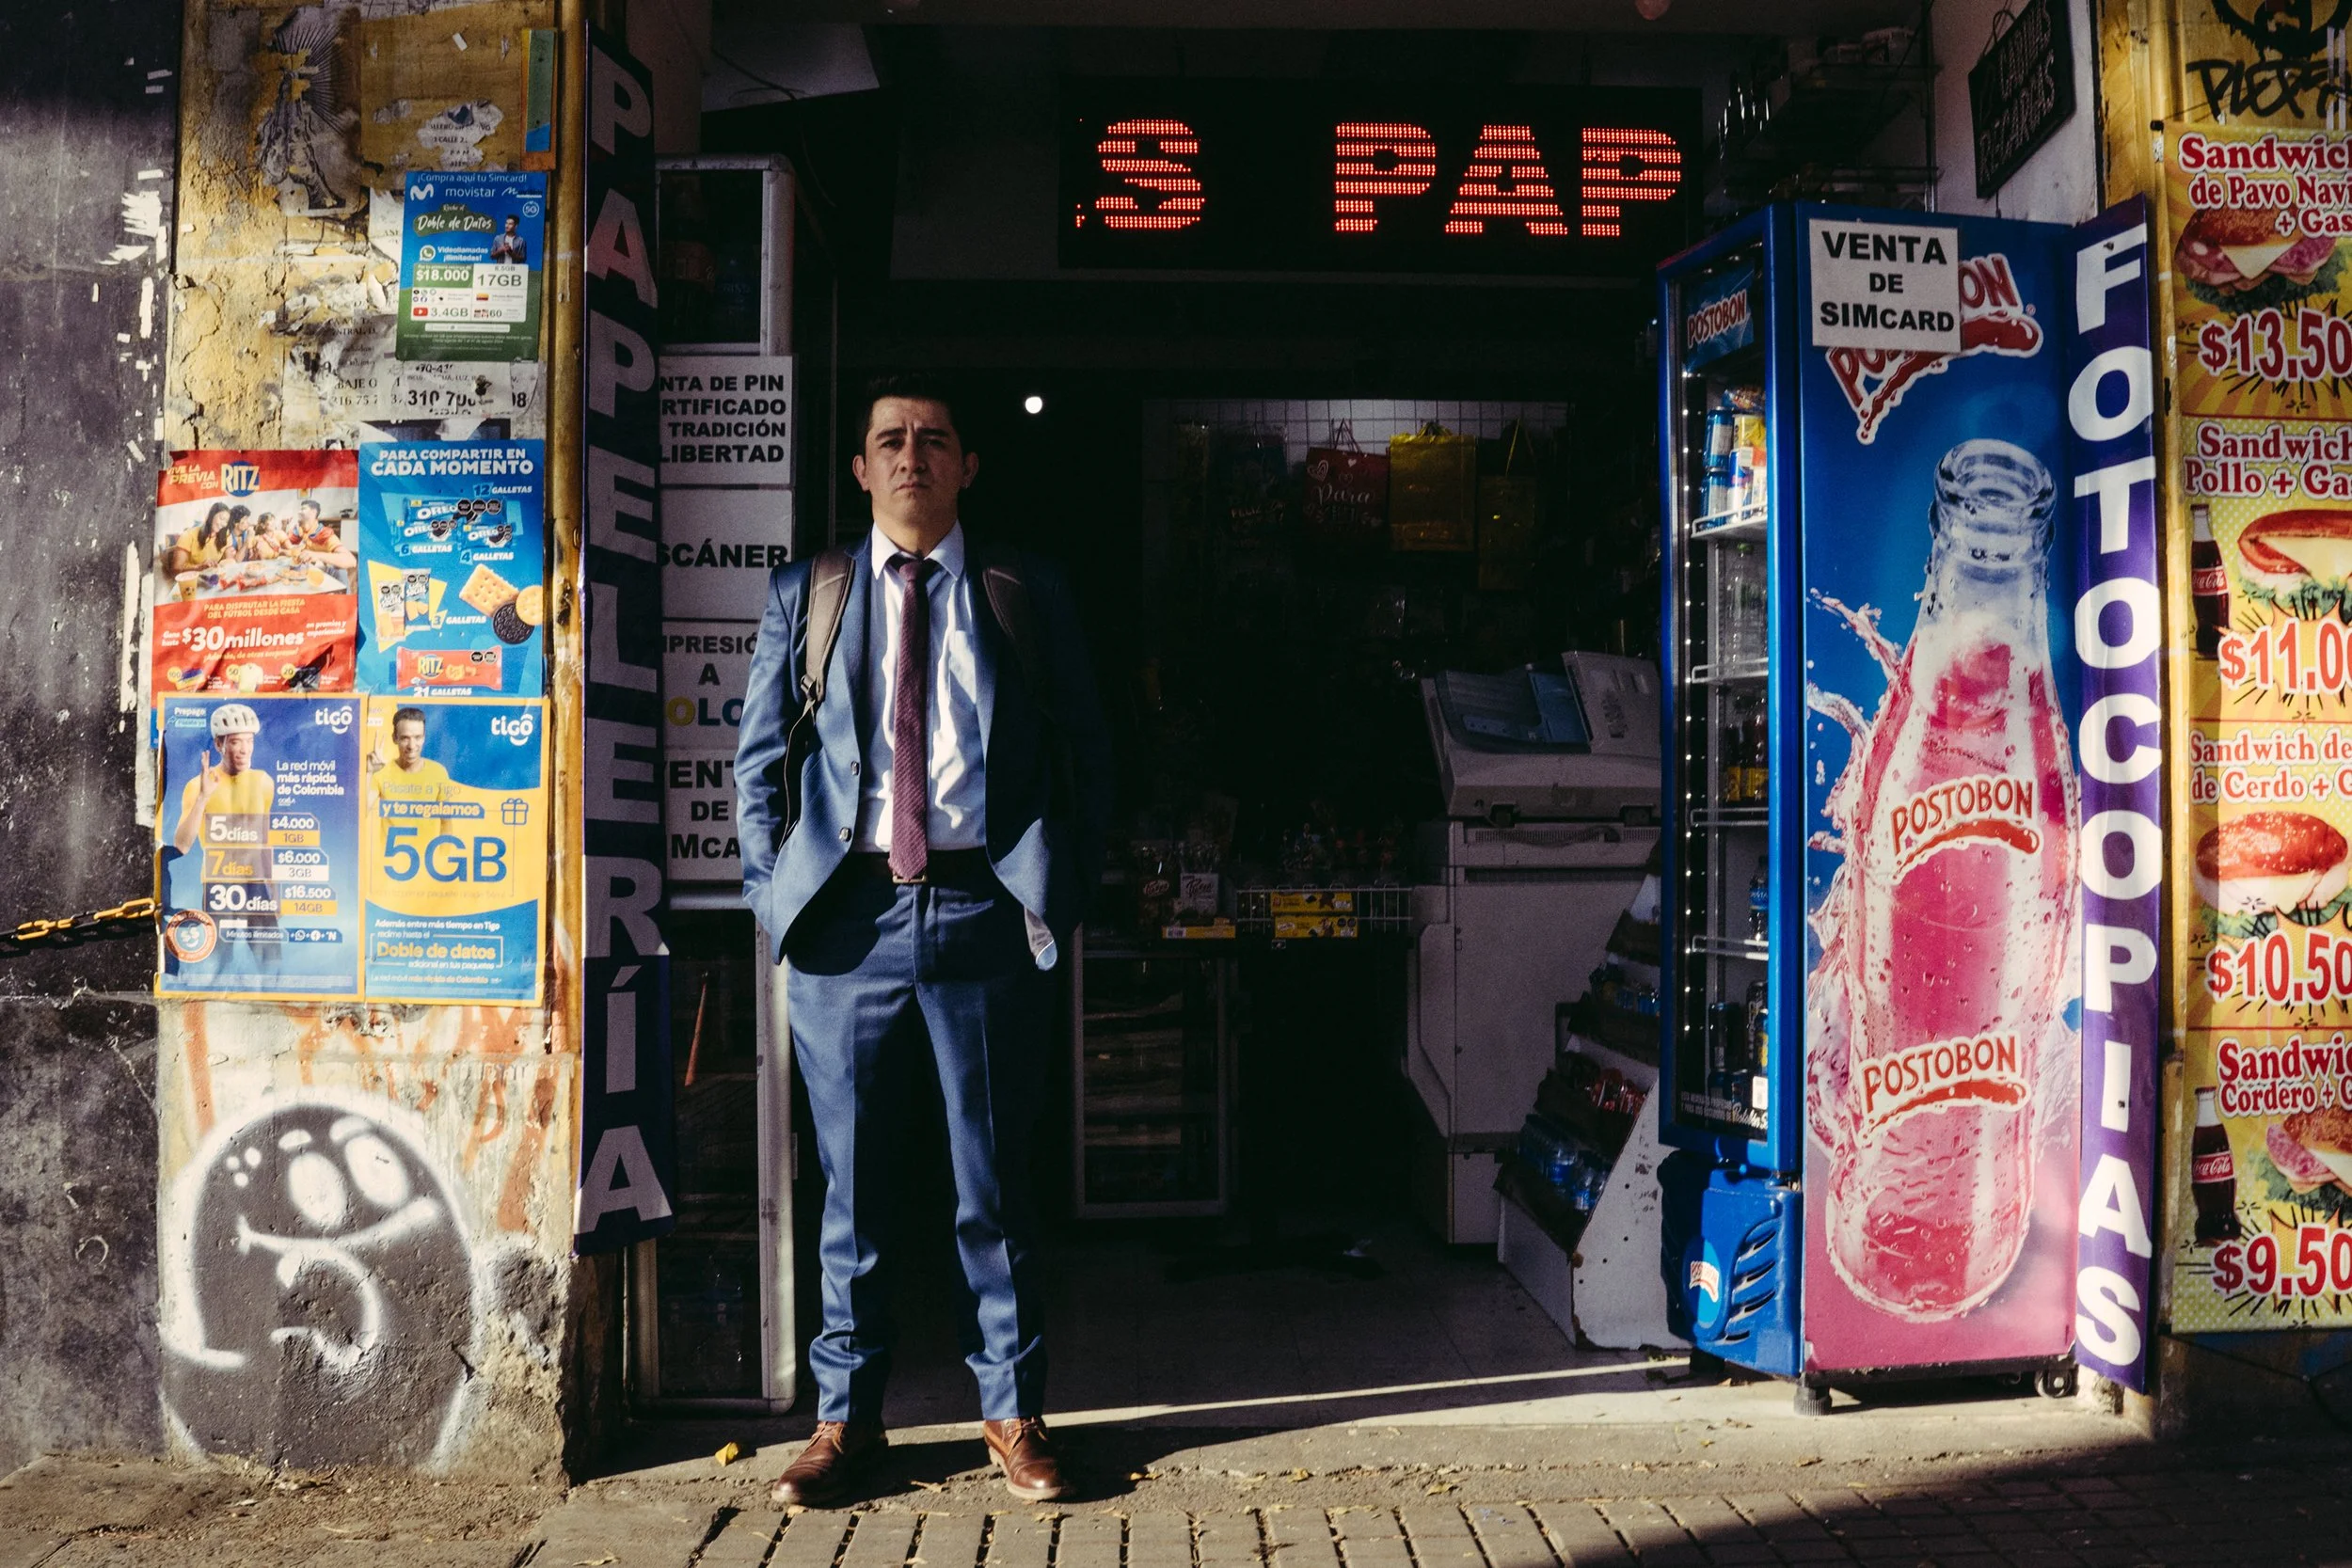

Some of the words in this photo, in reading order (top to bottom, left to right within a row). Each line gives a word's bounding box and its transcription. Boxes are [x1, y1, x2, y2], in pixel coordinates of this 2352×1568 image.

[418, 173, 455, 183] ¡Compra
[456, 173, 476, 185] aquí
[477, 174, 486, 182] tu
[488, 174, 527, 182] Simcard!
[1096, 119, 1205, 229] S
[1335, 122, 1682, 237] PAP
[445, 187, 496, 198] movistar
[2190, 177, 2222, 204] de
[2228, 176, 2290, 206] Pavo
[418, 214, 444, 230] Doble
[449, 215, 461, 230] de
[464, 215, 492, 230] Datos
[1820, 230, 1947, 265] VENTA
[416, 269, 469, 281] $18.000
[478, 274, 522, 287] 17GB
[1868, 273, 1904, 294] DE
[431, 308, 469, 317] 3.4GB
[1687, 289, 1747, 347] POSTOBON
[1820, 301, 1955, 332] SIMCARD
[660, 376, 703, 391] NTA
[710, 376, 737, 391] DE
[745, 375, 784, 391] PIN
[661, 398, 787, 415] RTIFICADO
[669, 419, 786, 437] TRADICIÓN
[379, 450, 418, 461] PARA
[420, 449, 503, 460] COMPARTIR
[507, 449, 526, 459] EN
[659, 444, 784, 463] LIBERTAD
[188, 463, 201, 473] LA
[371, 460, 426, 476] CADA
[430, 460, 533, 476] MOMENTO
[168, 471, 216, 485] PREVIA
[221, 463, 260, 492] RITZ
[2185, 460, 2264, 494] Pollo
[200, 482, 219, 490] CON
[474, 484, 490, 496] 12
[491, 485, 532, 494] GALLETAS
[417, 504, 459, 519] OREO
[401, 545, 409, 555] 6
[412, 545, 453, 553] GALLETAS
[461, 552, 470, 562] 4
[472, 552, 515, 561] GALLETAS
[446, 615, 486, 625] GALLETAS
[182, 626, 225, 652] $30
[225, 626, 305, 648] millones
[573, 43, 672, 1235] PAPELERÍA
[2220, 621, 2352, 691] $11.0
[418, 656, 444, 674] RITZ
[698, 663, 721, 686] A
[2190, 729, 2314, 764] Sandwich
[2324, 730, 2352, 759] de
[277, 760, 291, 771] La
[292, 760, 308, 771] red
[309, 759, 336, 771] móvil
[277, 772, 299, 784] más
[301, 772, 337, 784] rápida
[2192, 766, 2217, 800] de
[2224, 766, 2304, 800] Cerdo
[277, 784, 292, 795] de
[293, 784, 344, 796] Colombia
[2069, 223, 2163, 1367] FOTOCOPIAS
[382, 803, 392, 815] y
[393, 802, 409, 815] te
[410, 802, 480, 817] regalamos
[691, 800, 729, 822] DE
[1890, 778, 2036, 855] POSTOBON
[210, 816, 227, 842] 5
[227, 827, 258, 842] días
[272, 816, 314, 829] $4.000
[283, 832, 305, 843] 1GB
[278, 850, 321, 864] $6.000
[384, 826, 507, 882] 5GB
[208, 850, 225, 876] 7
[222, 862, 253, 876] días
[289, 867, 311, 878] 3GB
[209, 884, 246, 911] 30
[246, 896, 278, 911] días
[284, 885, 332, 899] $16.500
[294, 902, 323, 913] 14GB
[376, 942, 424, 958] Doble
[426, 942, 448, 958] de
[450, 943, 496, 960] datos
[1861, 1036, 2019, 1116] POSTOBON
[2220, 1082, 2315, 1114] Cordero
